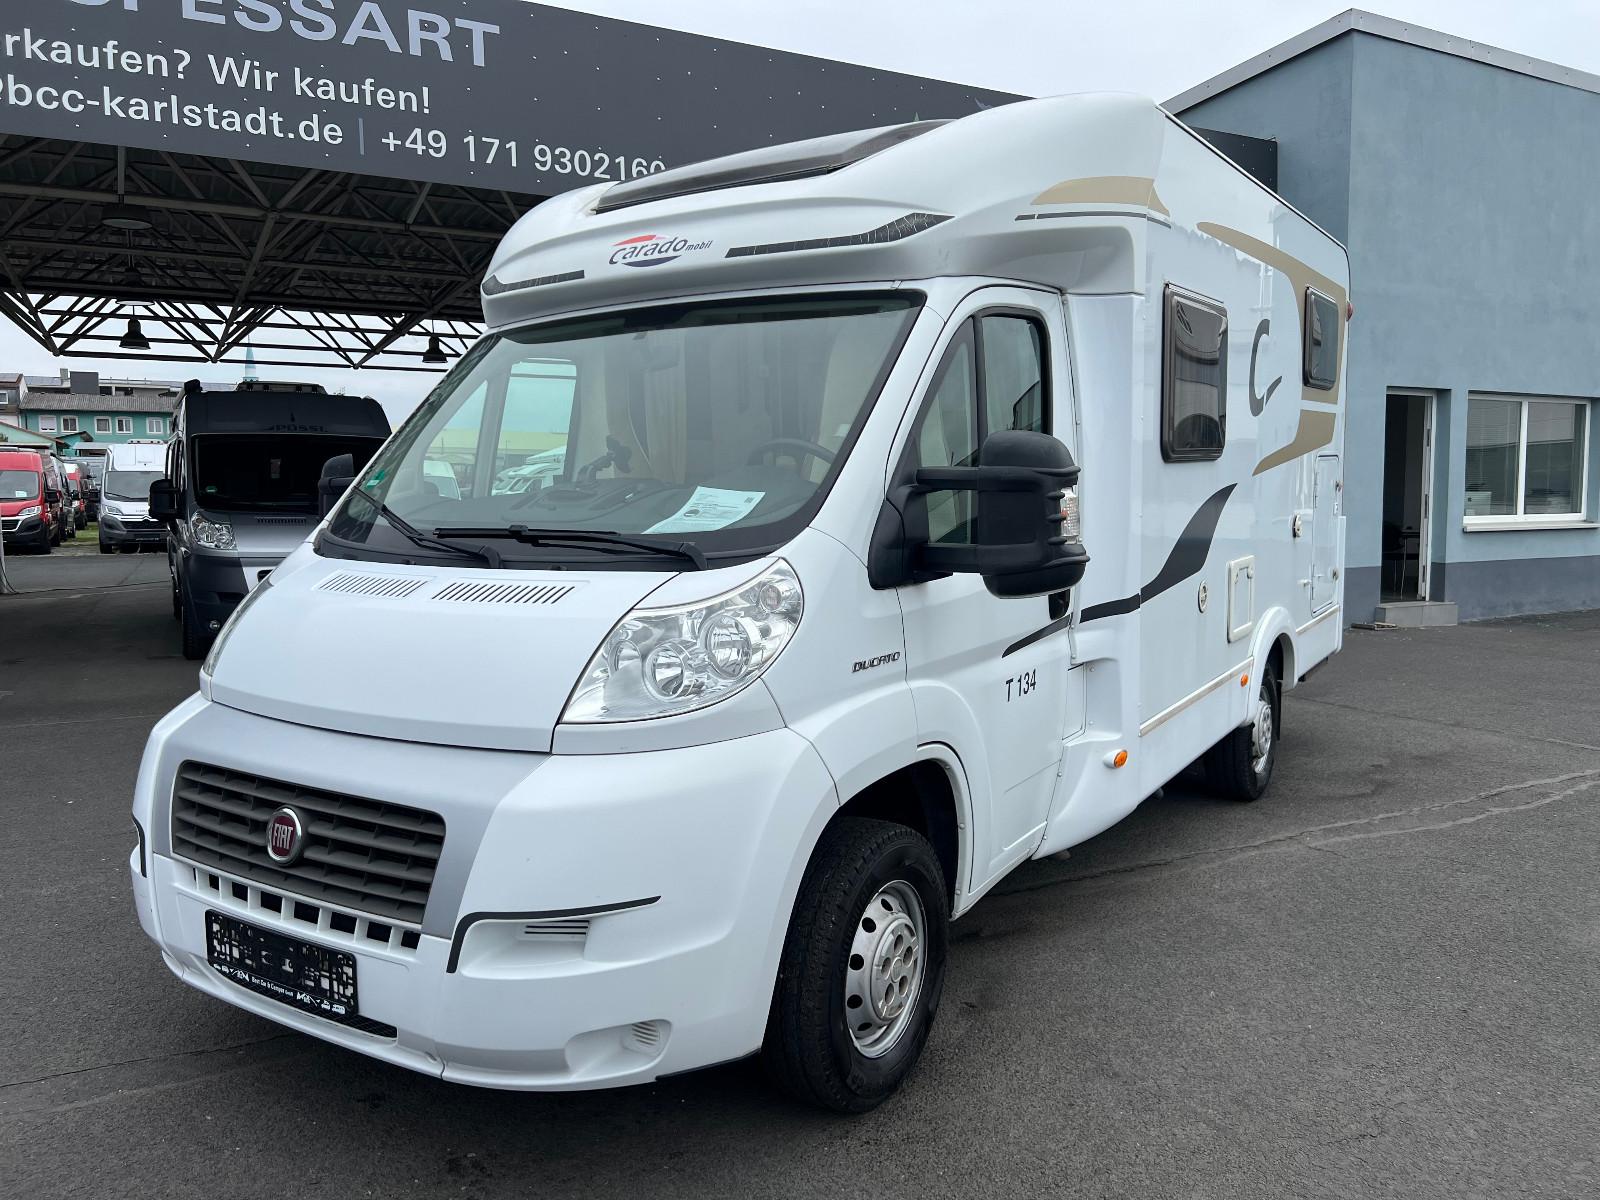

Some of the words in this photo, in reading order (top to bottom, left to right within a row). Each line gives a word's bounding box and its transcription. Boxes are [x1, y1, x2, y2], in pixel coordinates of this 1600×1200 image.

[70, 0, 501, 67] ESSART
[5, 28, 191, 79] rkaufen?
[207, 54, 279, 92] Wir
[294, 67, 431, 114] kaufen!
[0, 74, 343, 145] bcc-karlstadt.de
[381, 127, 447, 158] +49
[463, 135, 518, 167] 171
[685, 240, 713, 251] mobil
[851, 651, 901, 673] DUCATO
[1005, 678, 1013, 702] T
[1017, 668, 1037, 697] 134
[272, 823, 294, 850] FIAT
